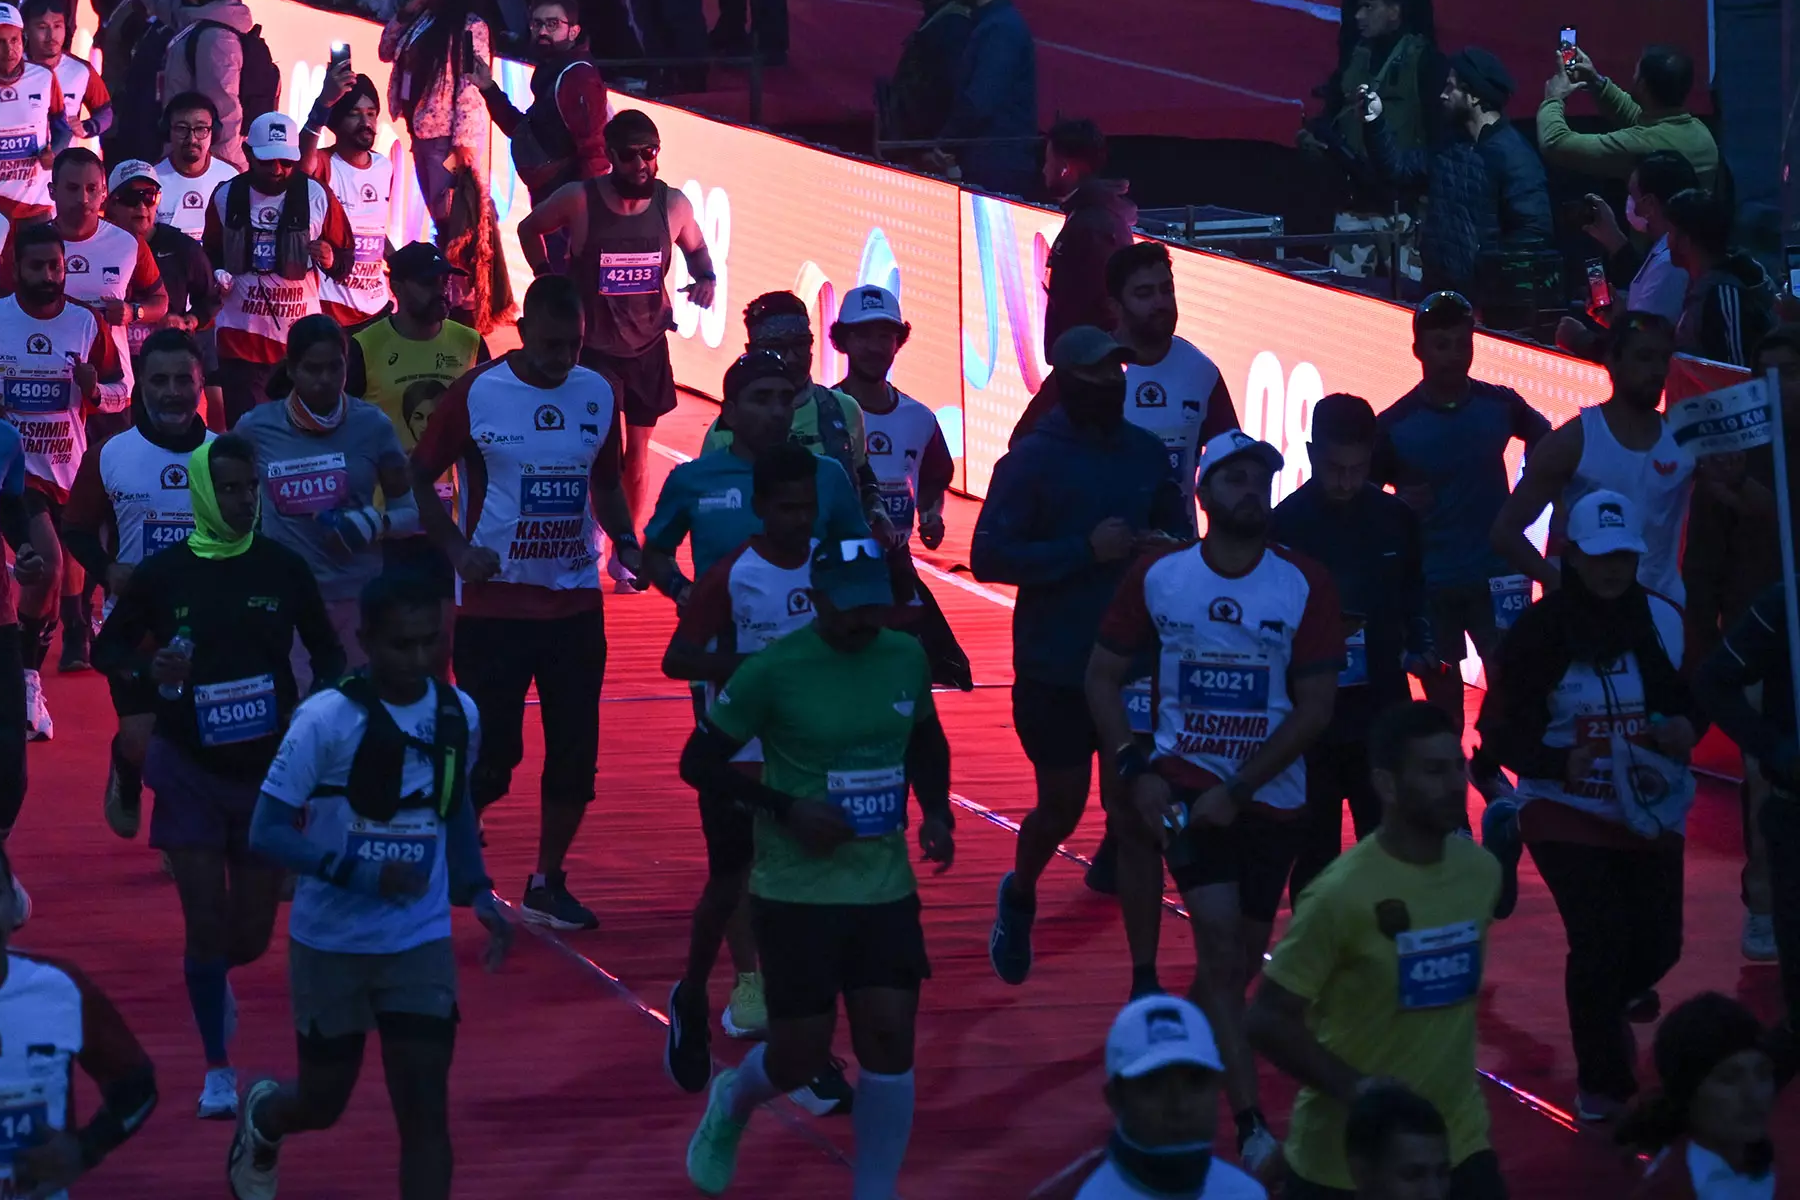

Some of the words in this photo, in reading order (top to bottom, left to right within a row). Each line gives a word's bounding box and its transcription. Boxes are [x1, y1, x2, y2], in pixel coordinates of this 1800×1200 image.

[354, 237, 380, 250] 5134
[607, 268, 653, 281] 42133
[248, 286, 304, 302] KASHMIR
[242, 302, 308, 318] MARATHON
[11, 383, 61, 397] 45096
[1740, 408, 1767, 427] KM
[20, 436, 74, 455] ARATHON
[51, 454, 72, 465] 2026
[280, 475, 337, 498] 47016
[530, 481, 580, 497] 45116
[888, 496, 909, 509] 137
[1502, 594, 1531, 611] 450
[1189, 670, 1254, 691] 42021
[208, 699, 267, 724] 45003
[1183, 712, 1269, 738] KASHMIR
[357, 839, 425, 863] 45029
